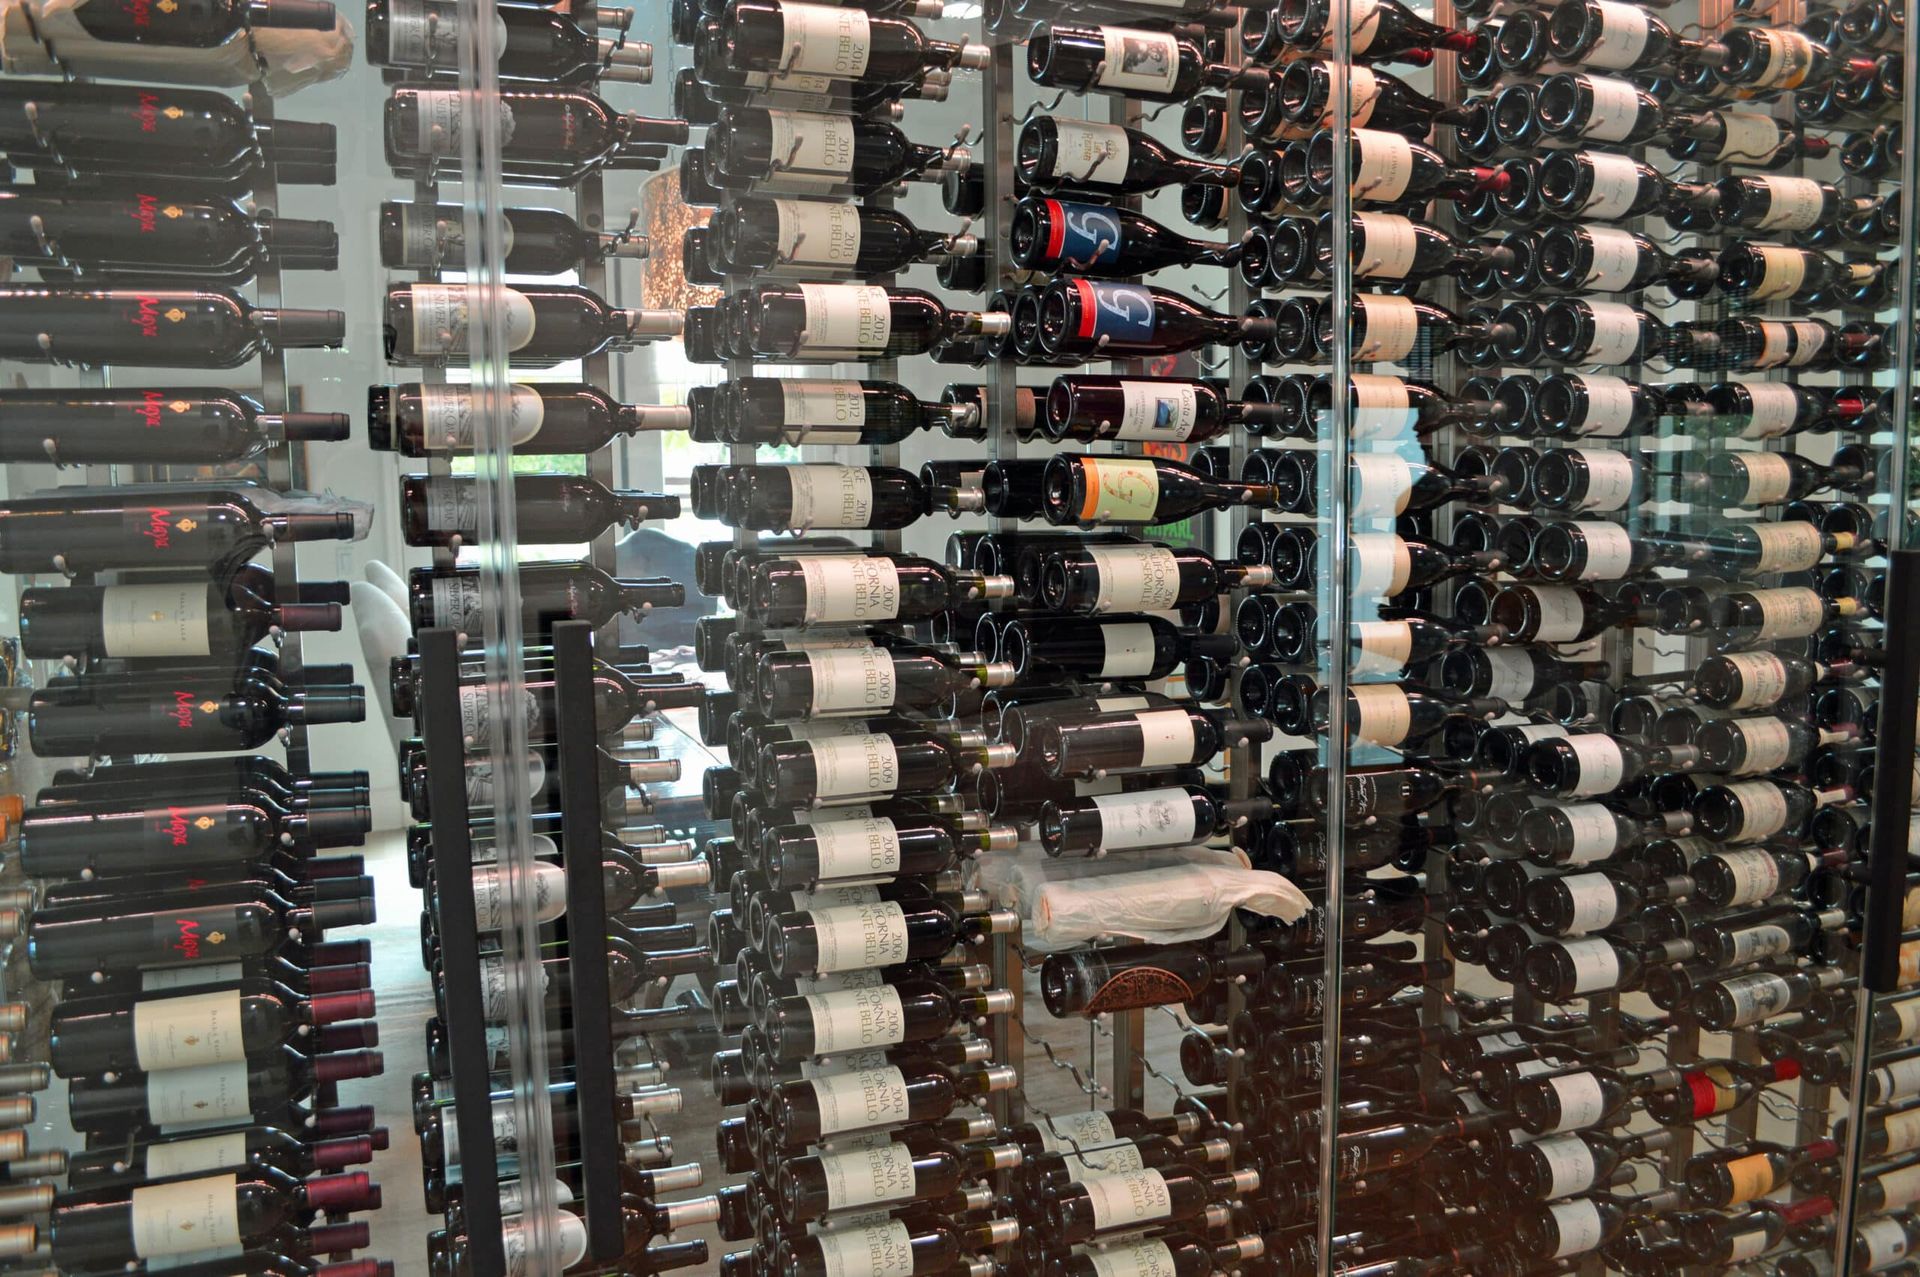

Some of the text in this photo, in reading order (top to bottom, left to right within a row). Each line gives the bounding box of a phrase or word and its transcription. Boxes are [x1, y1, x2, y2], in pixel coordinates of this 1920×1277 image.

[834, 35, 851, 72] BELLO
[851, 43, 865, 71] 2014
[131, 93, 160, 133] Maya
[823, 130, 837, 166] BELLO
[837, 136, 850, 164] 2014
[131, 194, 158, 233] Maya
[1066, 211, 1119, 250] G
[829, 223, 843, 259] BELLO
[842, 231, 856, 257] 2013
[131, 296, 160, 336] Maya
[431, 294, 448, 324] SILVER
[1097, 289, 1152, 327] G
[857, 307, 871, 344] BELLO
[873, 313, 886, 341] 2012
[134, 391, 163, 427] Maya
[833, 387, 847, 421] BELLO
[848, 392, 860, 418] 2012
[1174, 389, 1193, 438] Costa Azul
[1102, 471, 1155, 509] G
[840, 493, 855, 525] BELLO
[855, 499, 868, 522] 2011
[143, 508, 171, 549] Maya
[447, 582, 461, 612] SILVER
[854, 583, 867, 617] BELLO
[882, 585, 894, 613] 2007
[864, 669, 877, 704] BELLO
[879, 671, 891, 699] 2009
[169, 691, 194, 728] Maya
[463, 692, 474, 723] SILVER
[865, 753, 880, 788] BELLO
[882, 756, 893, 784] 2009
[162, 806, 190, 847] Maya
[868, 834, 882, 869] BELLO
[882, 836, 895, 865] 2008
[173, 919, 201, 960] Maya
[864, 932, 877, 965] BELLO
[891, 932, 903, 959] 2006
[859, 1010, 873, 1045] BELLO
[886, 1010, 899, 1038] 2006
[863, 1086, 878, 1121] BELLO
[891, 1087, 904, 1114] 2004
[871, 1161, 887, 1197] BELLO
[898, 1162, 911, 1190] 2004
[1128, 1183, 1144, 1216] BELLO
[1152, 1183, 1166, 1207] 2001
[868, 1243, 883, 1277] BELLO
[896, 1243, 909, 1270] 2004
